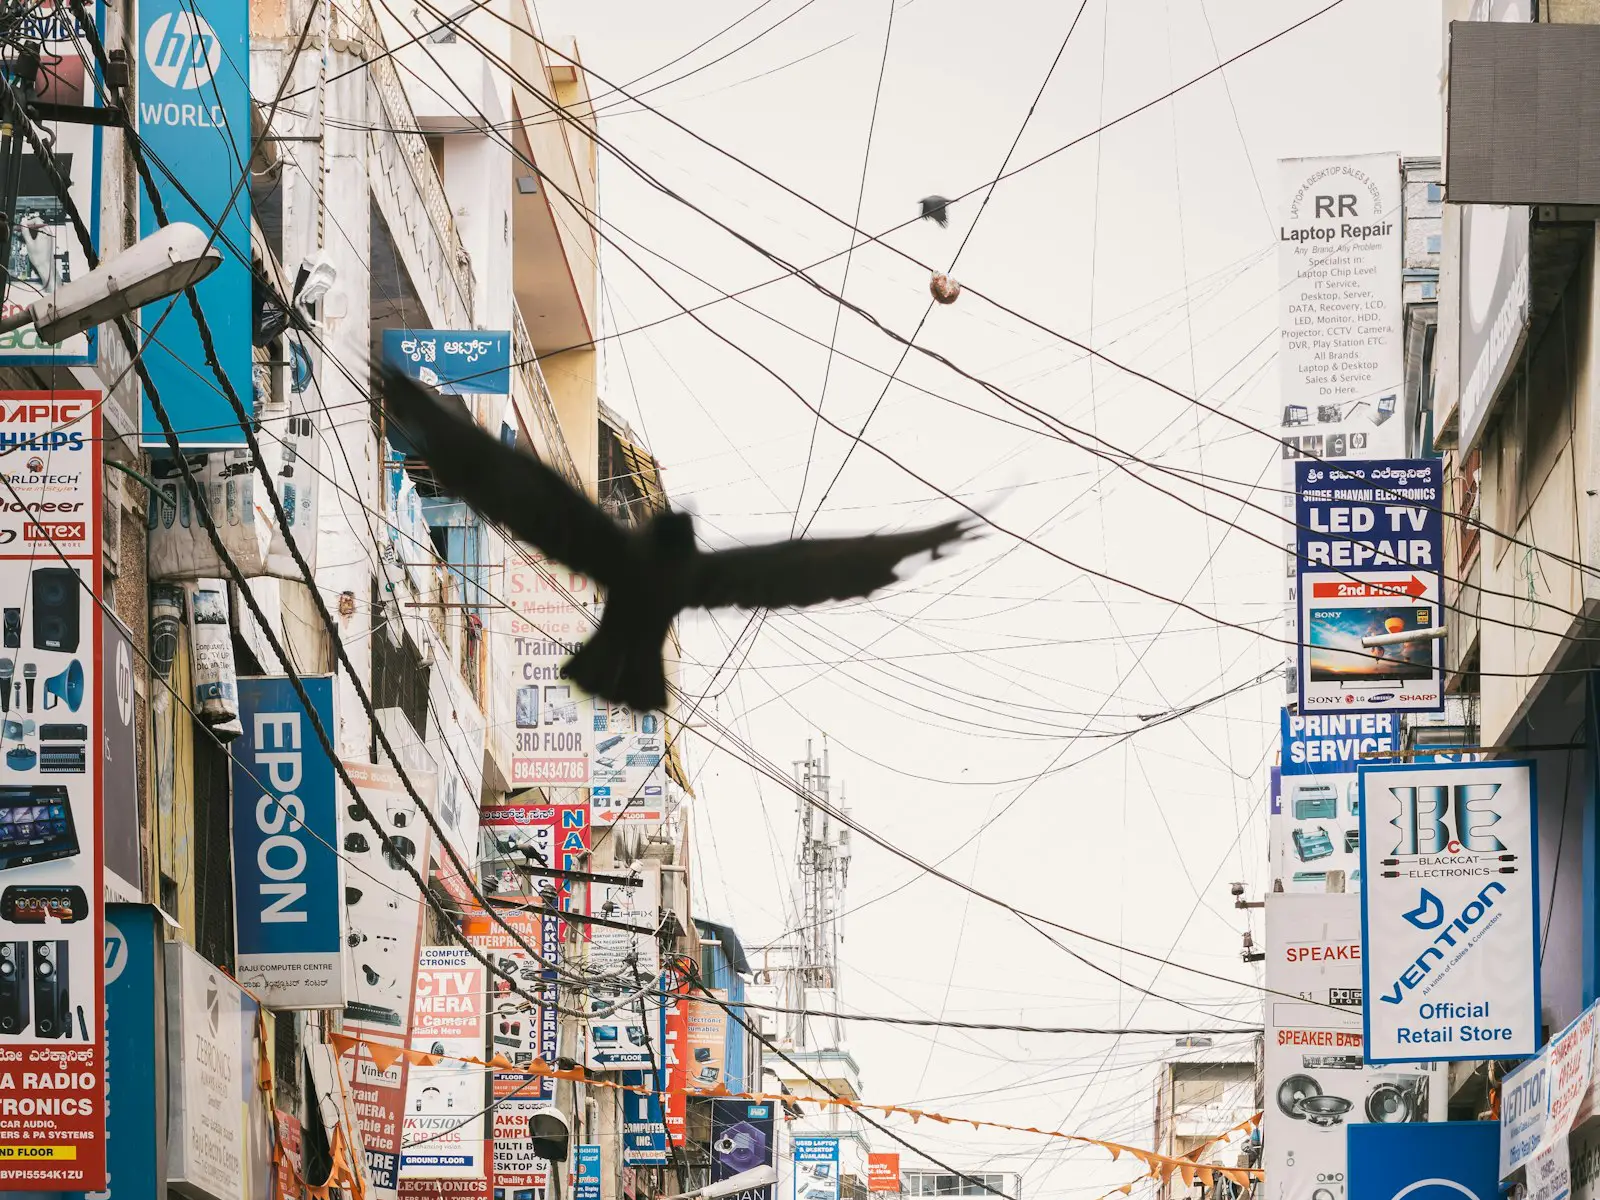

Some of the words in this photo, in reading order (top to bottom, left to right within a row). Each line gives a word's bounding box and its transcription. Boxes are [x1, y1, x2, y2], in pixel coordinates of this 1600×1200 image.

[150, 11, 210, 90] hp
[141, 102, 227, 129] WORLD
[1291, 188, 1303, 219] LAPTOP
[1307, 166, 1340, 187] DESKTOP
[1342, 165, 1365, 181] SALES
[1367, 182, 1382, 215] SERVICE
[1315, 194, 1358, 219] RR
[1280, 226, 1336, 243] Laptop
[1341, 221, 1393, 241] Repair
[1308, 257, 1350, 267] Specialist
[1297, 269, 1328, 279] Laptop
[1330, 268, 1351, 278] Chip
[1354, 266, 1377, 275] Level
[1314, 281, 1323, 289] IT
[1289, 304, 1317, 313] DATA,
[1327, 326, 1352, 336] CCTV
[1313, 340, 1331, 349] Play
[1334, 338, 1365, 347] Station
[1314, 352, 1326, 360] All
[1329, 351, 1359, 360] Brands
[1298, 364, 1329, 373] Laptop
[1331, 362, 1339, 371] &
[1341, 361, 1379, 370] Desktop
[1305, 375, 1328, 384] Sales
[1330, 374, 1338, 383] &
[1340, 373, 1371, 383] Service
[1319, 386, 1332, 395] Do
[0, 431, 84, 451] HILIPS
[1306, 468, 1324, 483] ಶ್ರೀ
[1302, 489, 1333, 502] SHREE
[1334, 488, 1373, 501] BHAVANI
[1375, 487, 1436, 501] ELECTRONICS
[1309, 507, 1375, 533] LED
[1384, 506, 1429, 532] TV
[1307, 540, 1433, 566] REPAIR
[1337, 584, 1367, 596] 2nd
[1369, 584, 1408, 595] Floor
[523, 601, 575, 614] Mobile
[1314, 611, 1342, 619] SONY
[511, 619, 570, 634] Service
[576, 619, 588, 634] &
[1308, 696, 1342, 704] SONY
[1399, 694, 1438, 702] SHARP
[1289, 713, 1392, 738] PRINTER
[515, 732, 540, 752] 3RD
[543, 732, 583, 752] FLOOR
[1290, 737, 1392, 764] SERVICE
[514, 761, 584, 780] 9845434786
[253, 712, 307, 924] EPSON
[1418, 855, 1480, 866] BLACKCAT
[1409, 867, 1490, 878] ELECTRONICS
[1380, 881, 1507, 1006] VENTION
[1429, 972, 1446, 989] kinds
[1450, 946, 1469, 968] Cables
[1471, 911, 1503, 944] Connectors
[1286, 945, 1361, 963] SPEAKE
[260, 964, 302, 972] COMPUTER
[303, 963, 333, 971] CENTRE
[419, 958, 466, 966] CTRONICS
[416, 971, 475, 996] CTV
[415, 996, 474, 1013] MERA
[1418, 1002, 1490, 1020] Official
[422, 1014, 477, 1027] Camera
[1278, 1030, 1333, 1047] SPEAKER
[1396, 1026, 1453, 1044] Retail
[1459, 1024, 1513, 1042] Store
[23, 1072, 96, 1090] RADIO
[23, 1121, 57, 1129] AUDIO,
[383, 1122, 395, 1135] at
[624, 1123, 665, 1134] COMPUTER
[22, 1131, 30, 1139] &
[33, 1131, 46, 1139] PA
[48, 1131, 95, 1140] SYSTEMS
[413, 1132, 428, 1143] CP
[431, 1132, 461, 1143] PLUS
[364, 1135, 394, 1151] Price
[18, 1148, 54, 1157] FLOOR
[405, 1156, 438, 1164] GROUND
[439, 1156, 465, 1164] FLOOR
[398, 1181, 488, 1192] LECTRONICS
[499, 1175, 526, 1185] Quality
[526, 1175, 533, 1184] &
